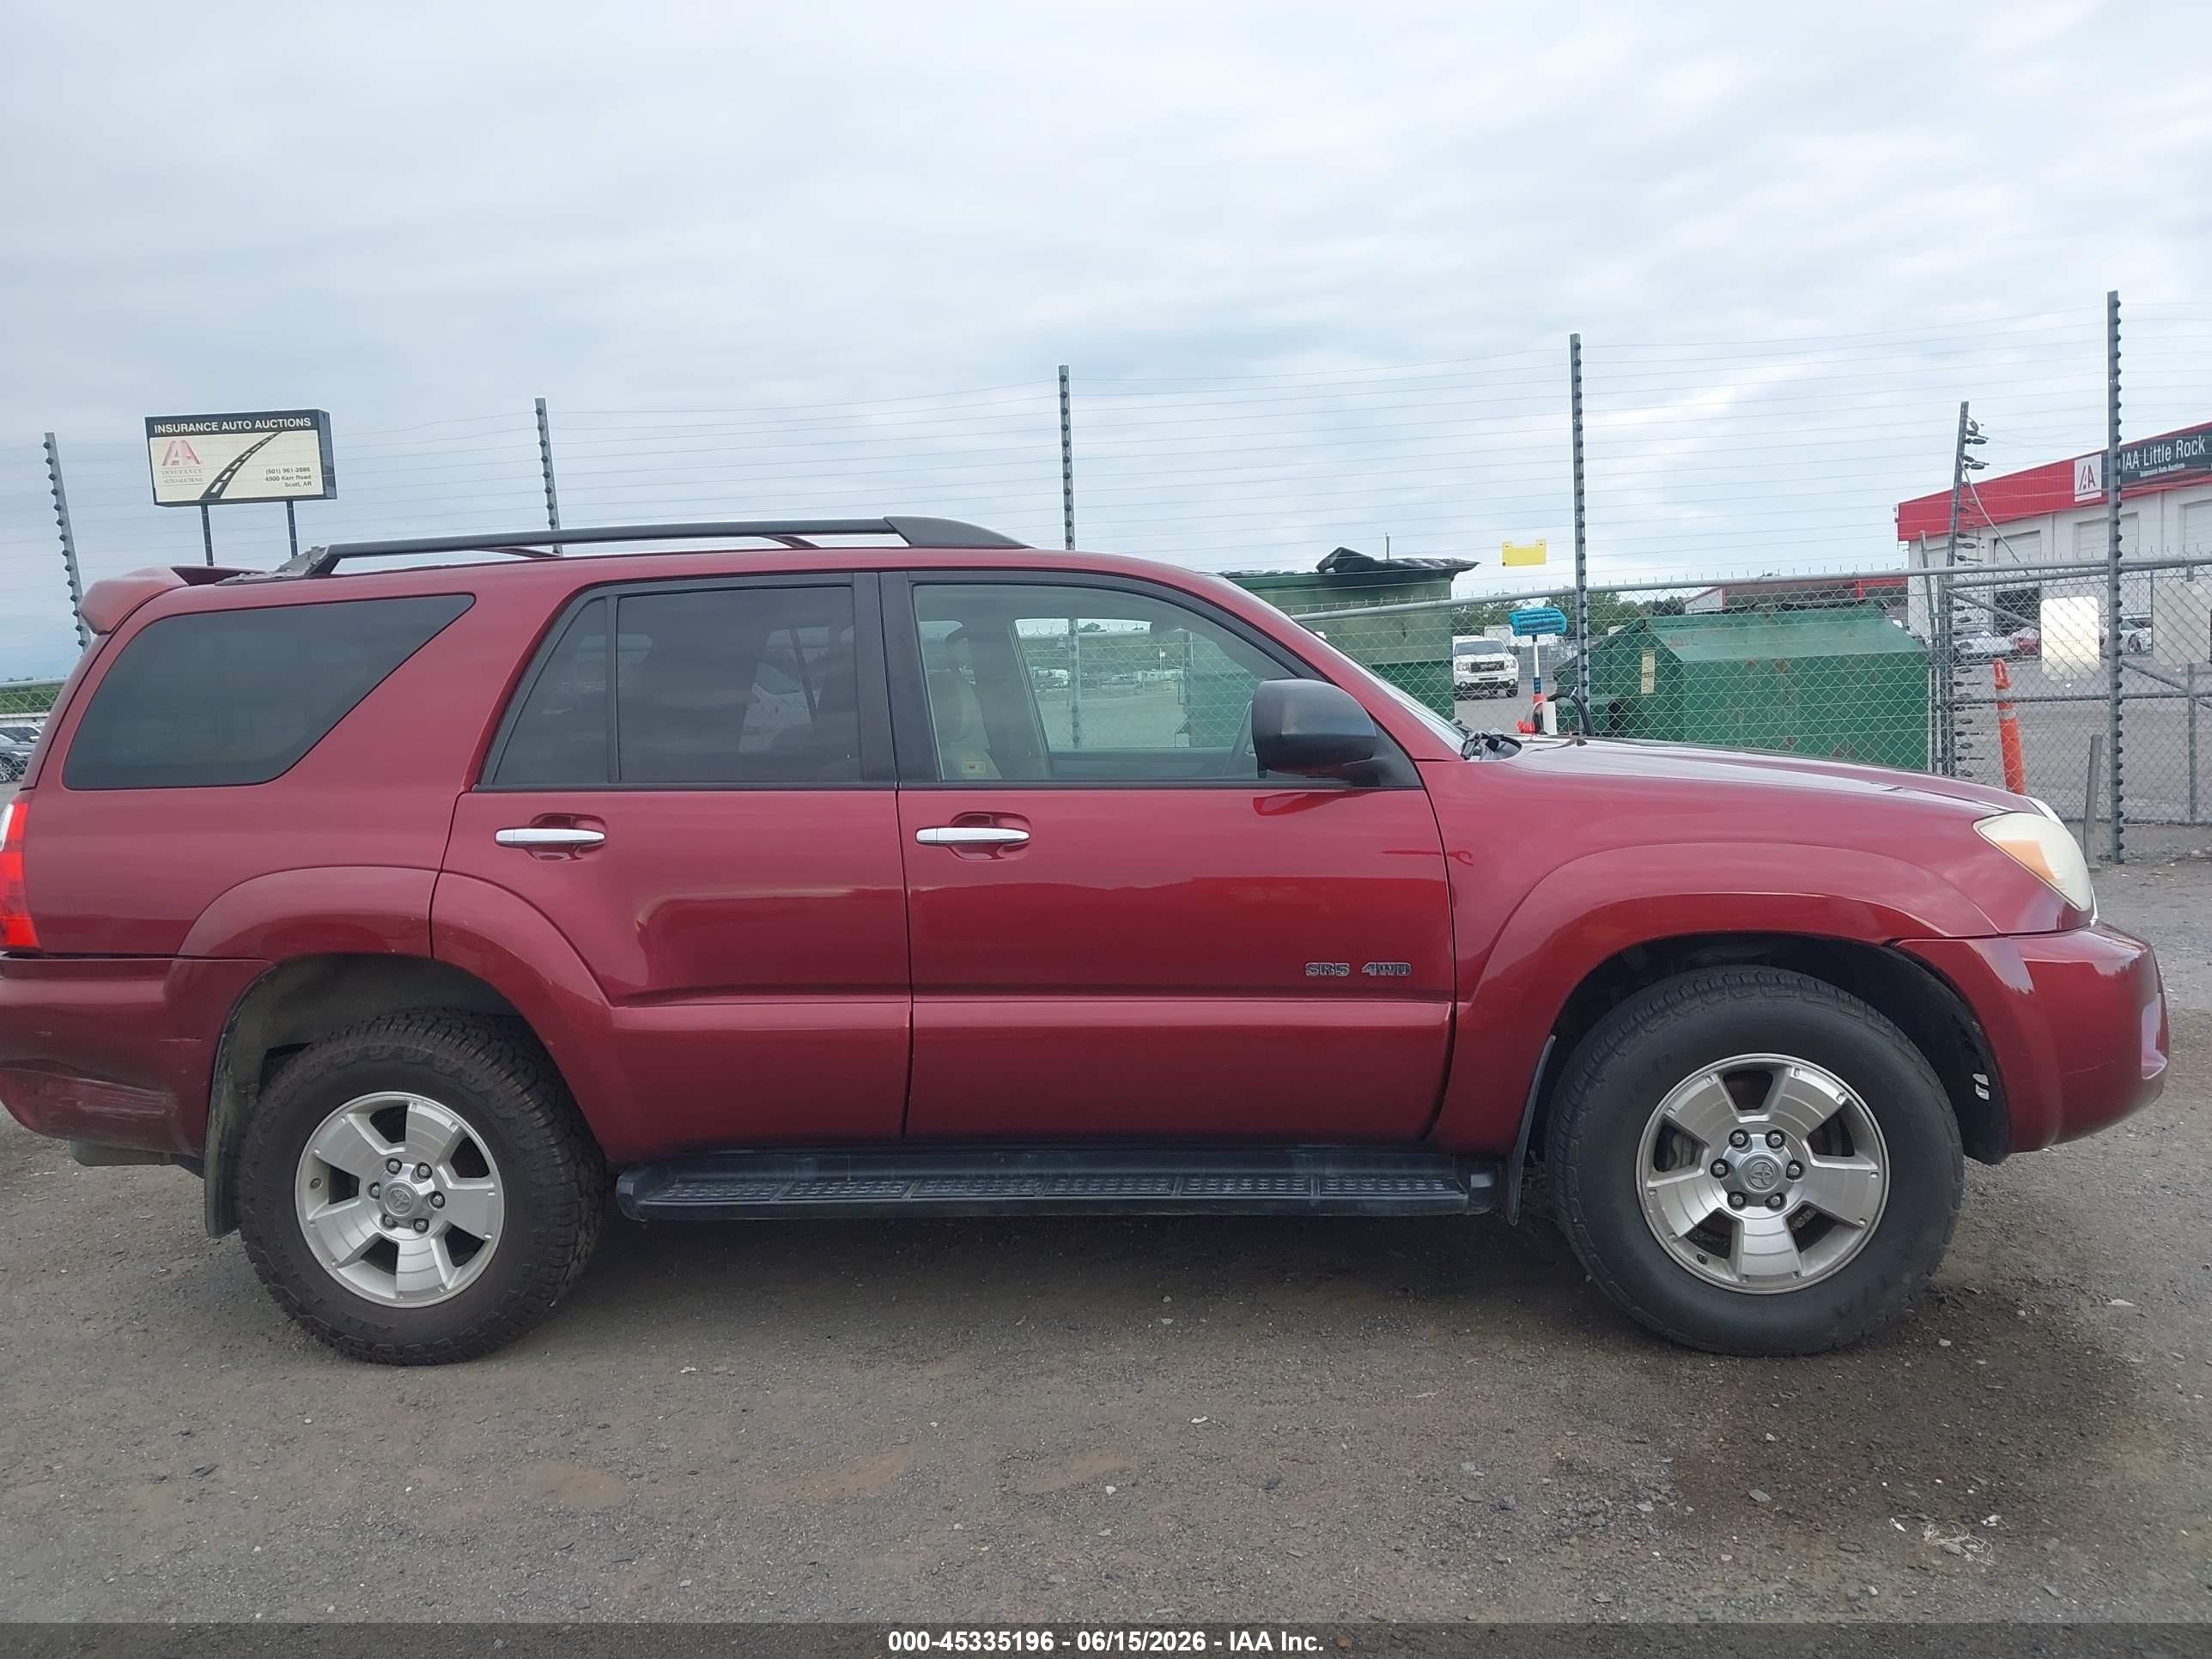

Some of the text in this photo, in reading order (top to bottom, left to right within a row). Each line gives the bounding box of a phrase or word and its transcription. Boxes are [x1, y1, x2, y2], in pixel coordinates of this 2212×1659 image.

[155, 417, 312, 434] INSURANCE AUTO AUCTIONS
[2123, 434, 2206, 471] IAA Little Rock
[1305, 962, 1412, 977] SR5 4WD
